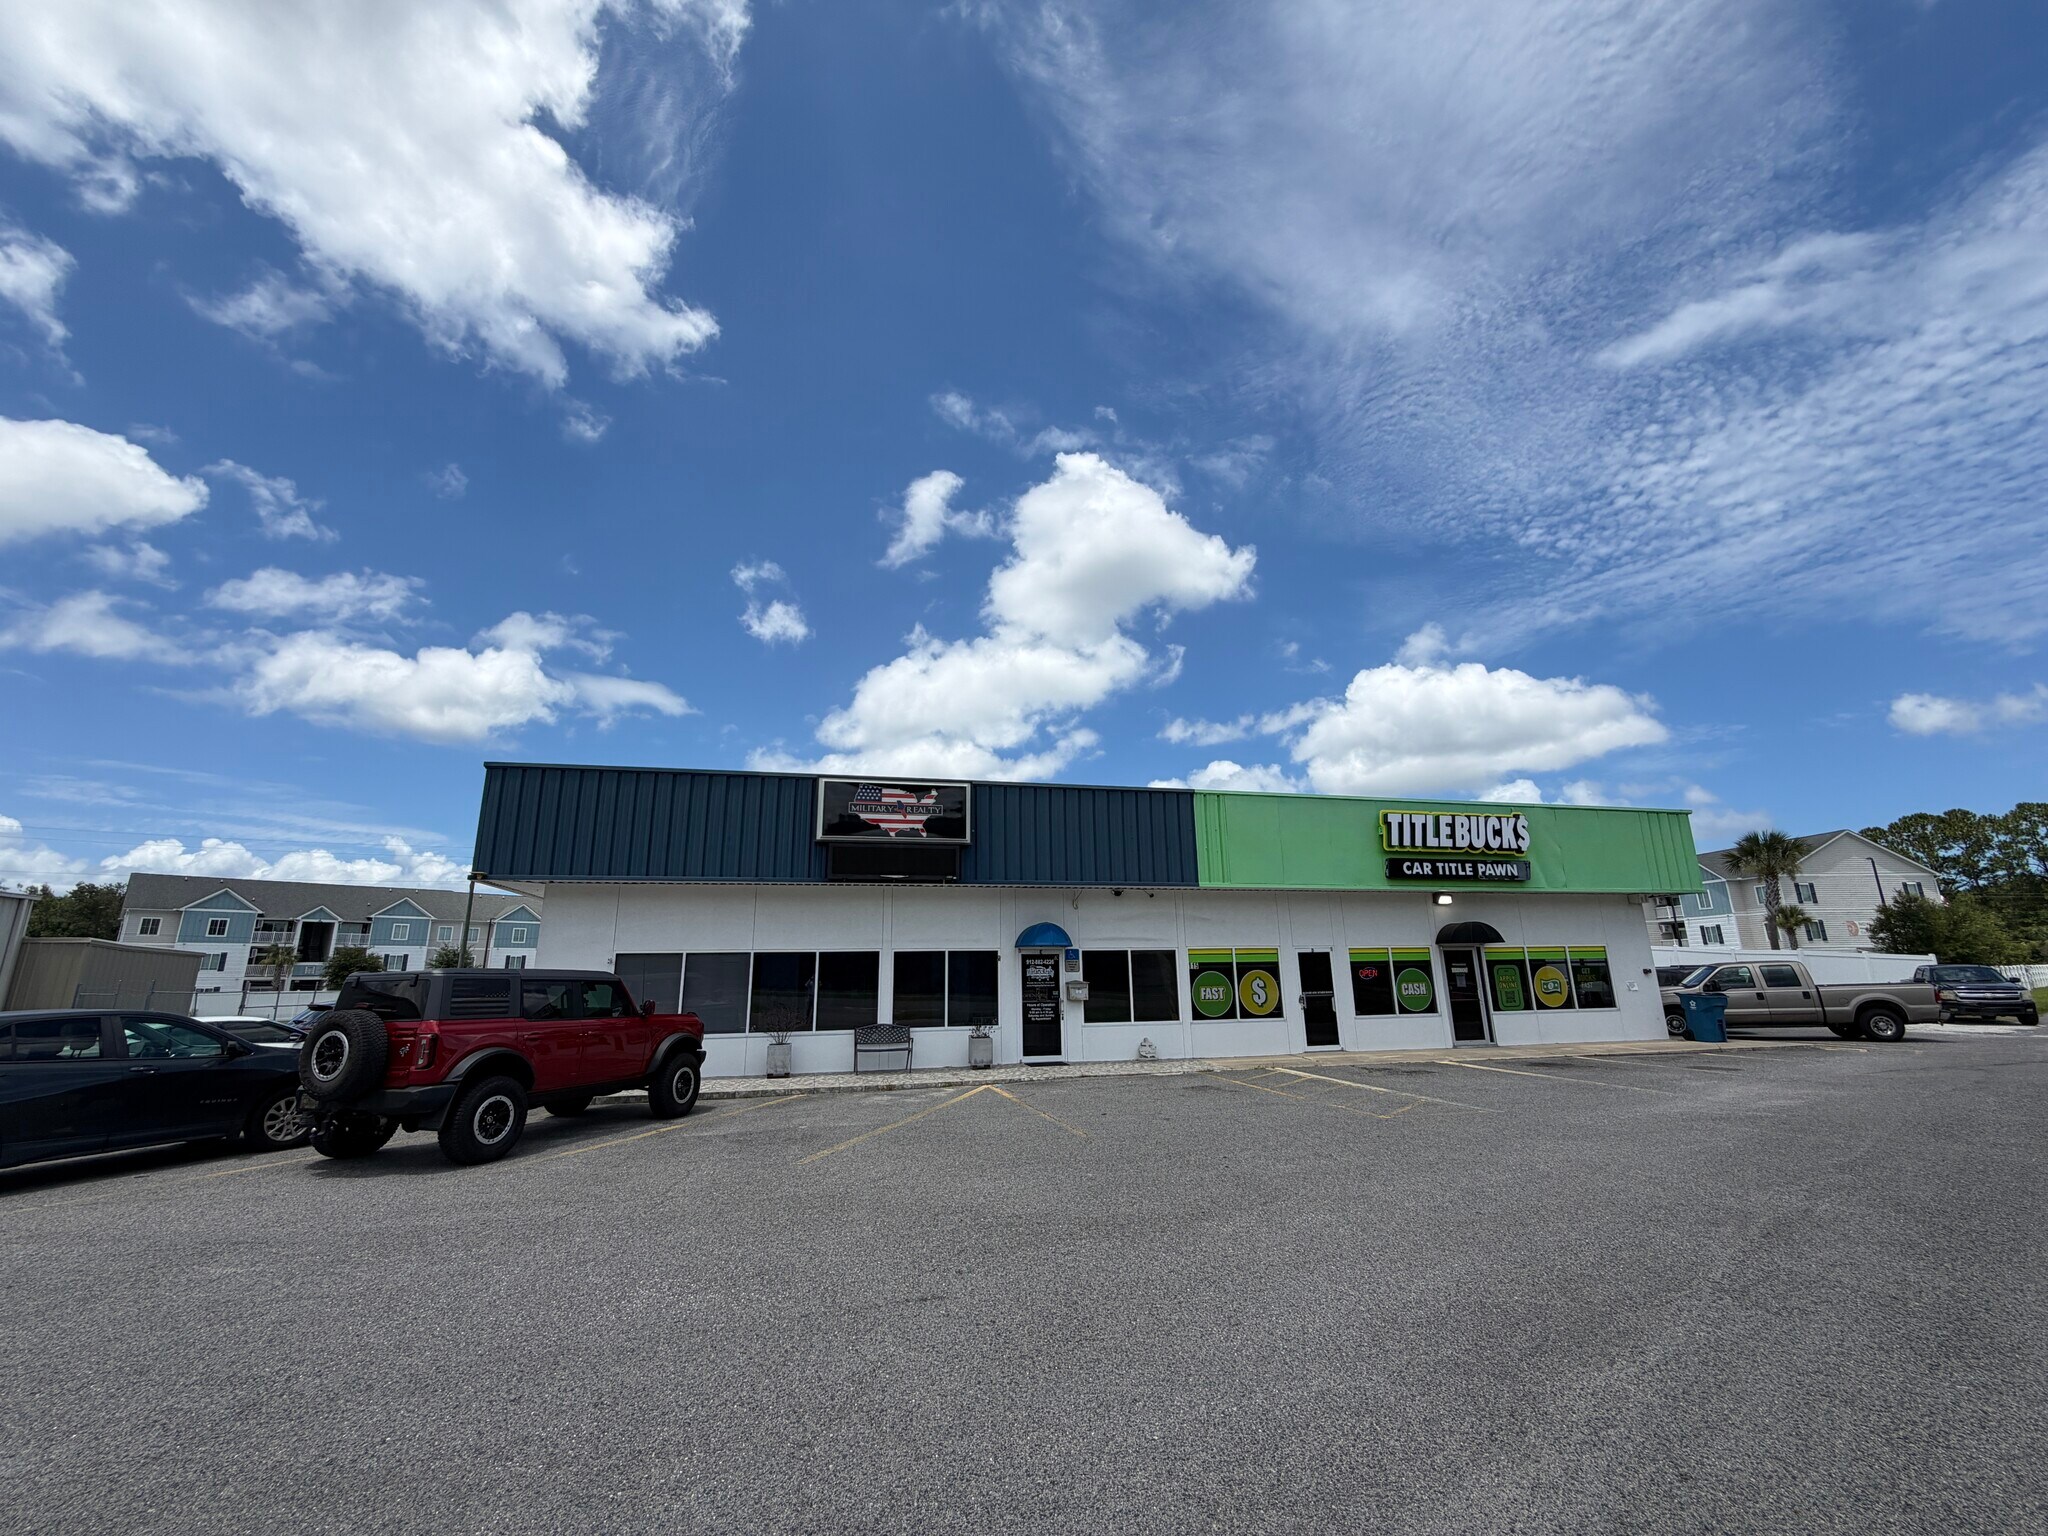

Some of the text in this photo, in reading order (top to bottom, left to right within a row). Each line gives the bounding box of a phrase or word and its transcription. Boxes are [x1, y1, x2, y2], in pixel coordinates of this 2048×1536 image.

[851, 804, 941, 814] MILITARY REALTY
[1403, 862, 1518, 876] CAR TITLE PAWN
[1359, 969, 1377, 978] OPEN
[1200, 986, 1225, 1001] FAST
[1401, 982, 1427, 996] CASH
